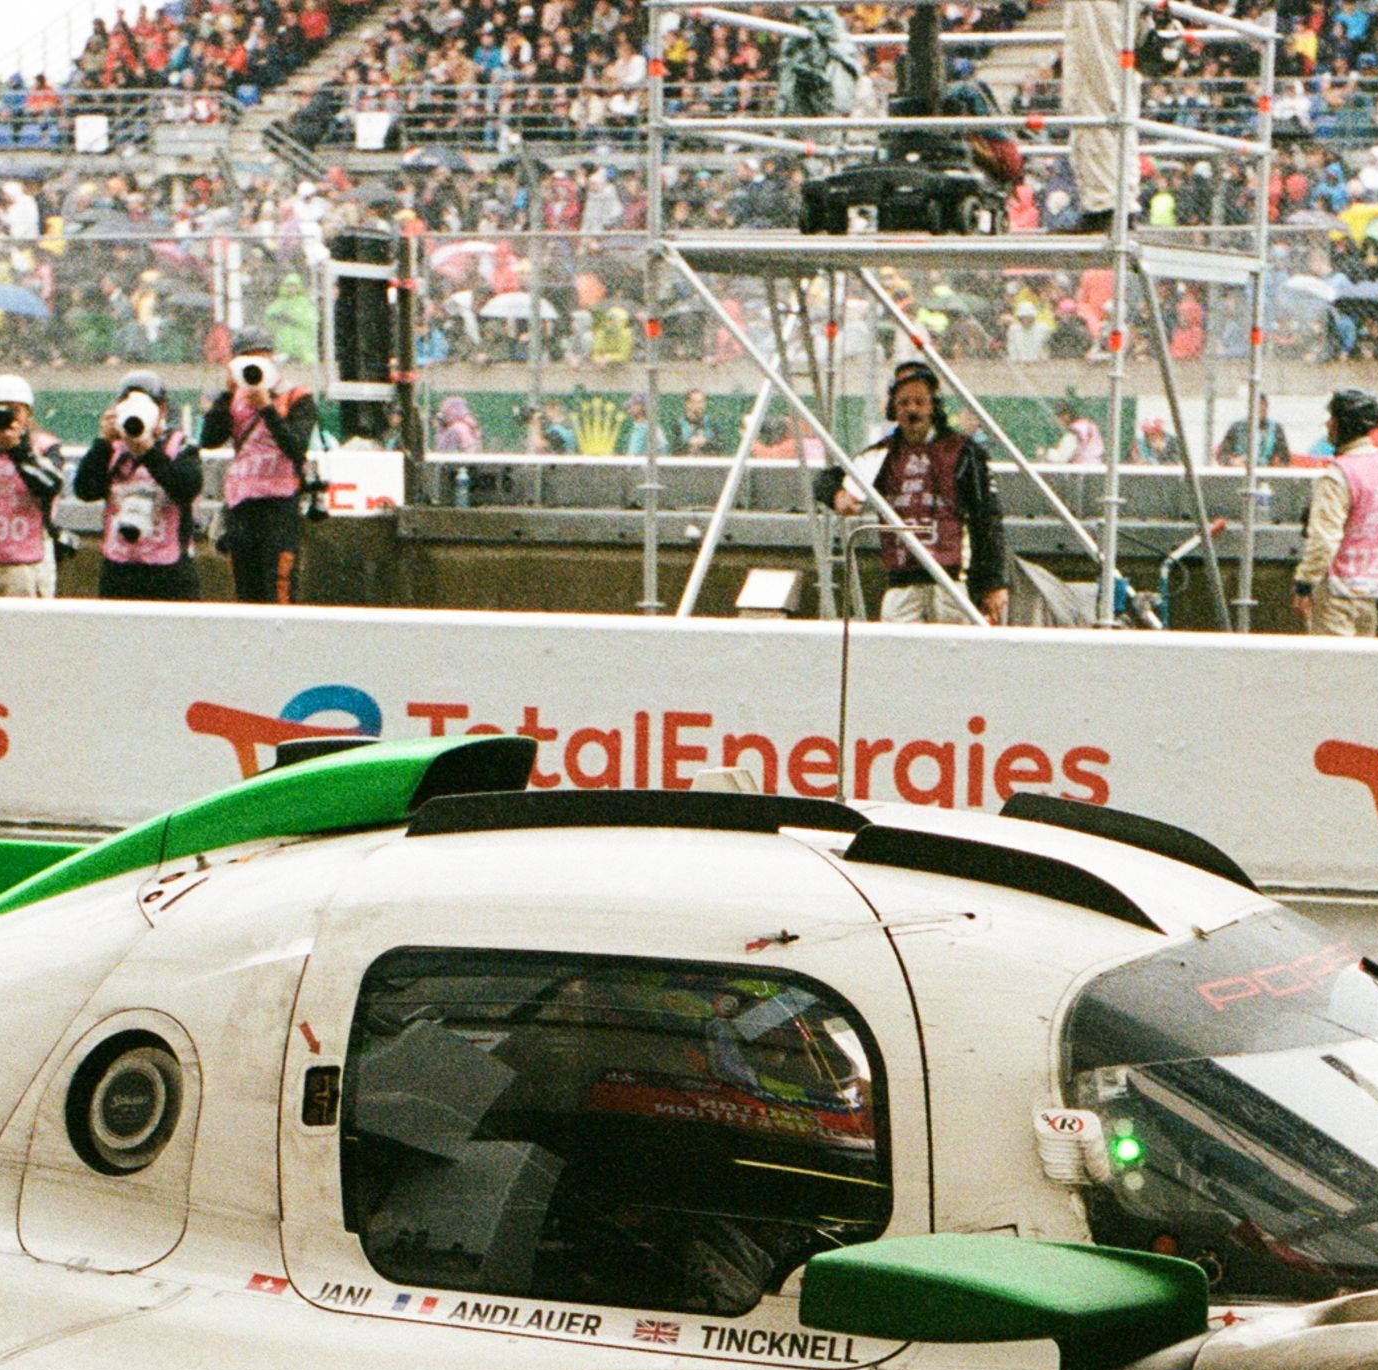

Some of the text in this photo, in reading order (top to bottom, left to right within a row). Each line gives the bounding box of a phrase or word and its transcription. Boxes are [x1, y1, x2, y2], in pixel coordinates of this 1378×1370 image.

[408, 703, 1111, 807] TtalEnergies
[310, 1282, 373, 1309] JANI
[447, 1301, 603, 1337] ANDLAUER
[699, 1324, 862, 1364] TINCKNELL
